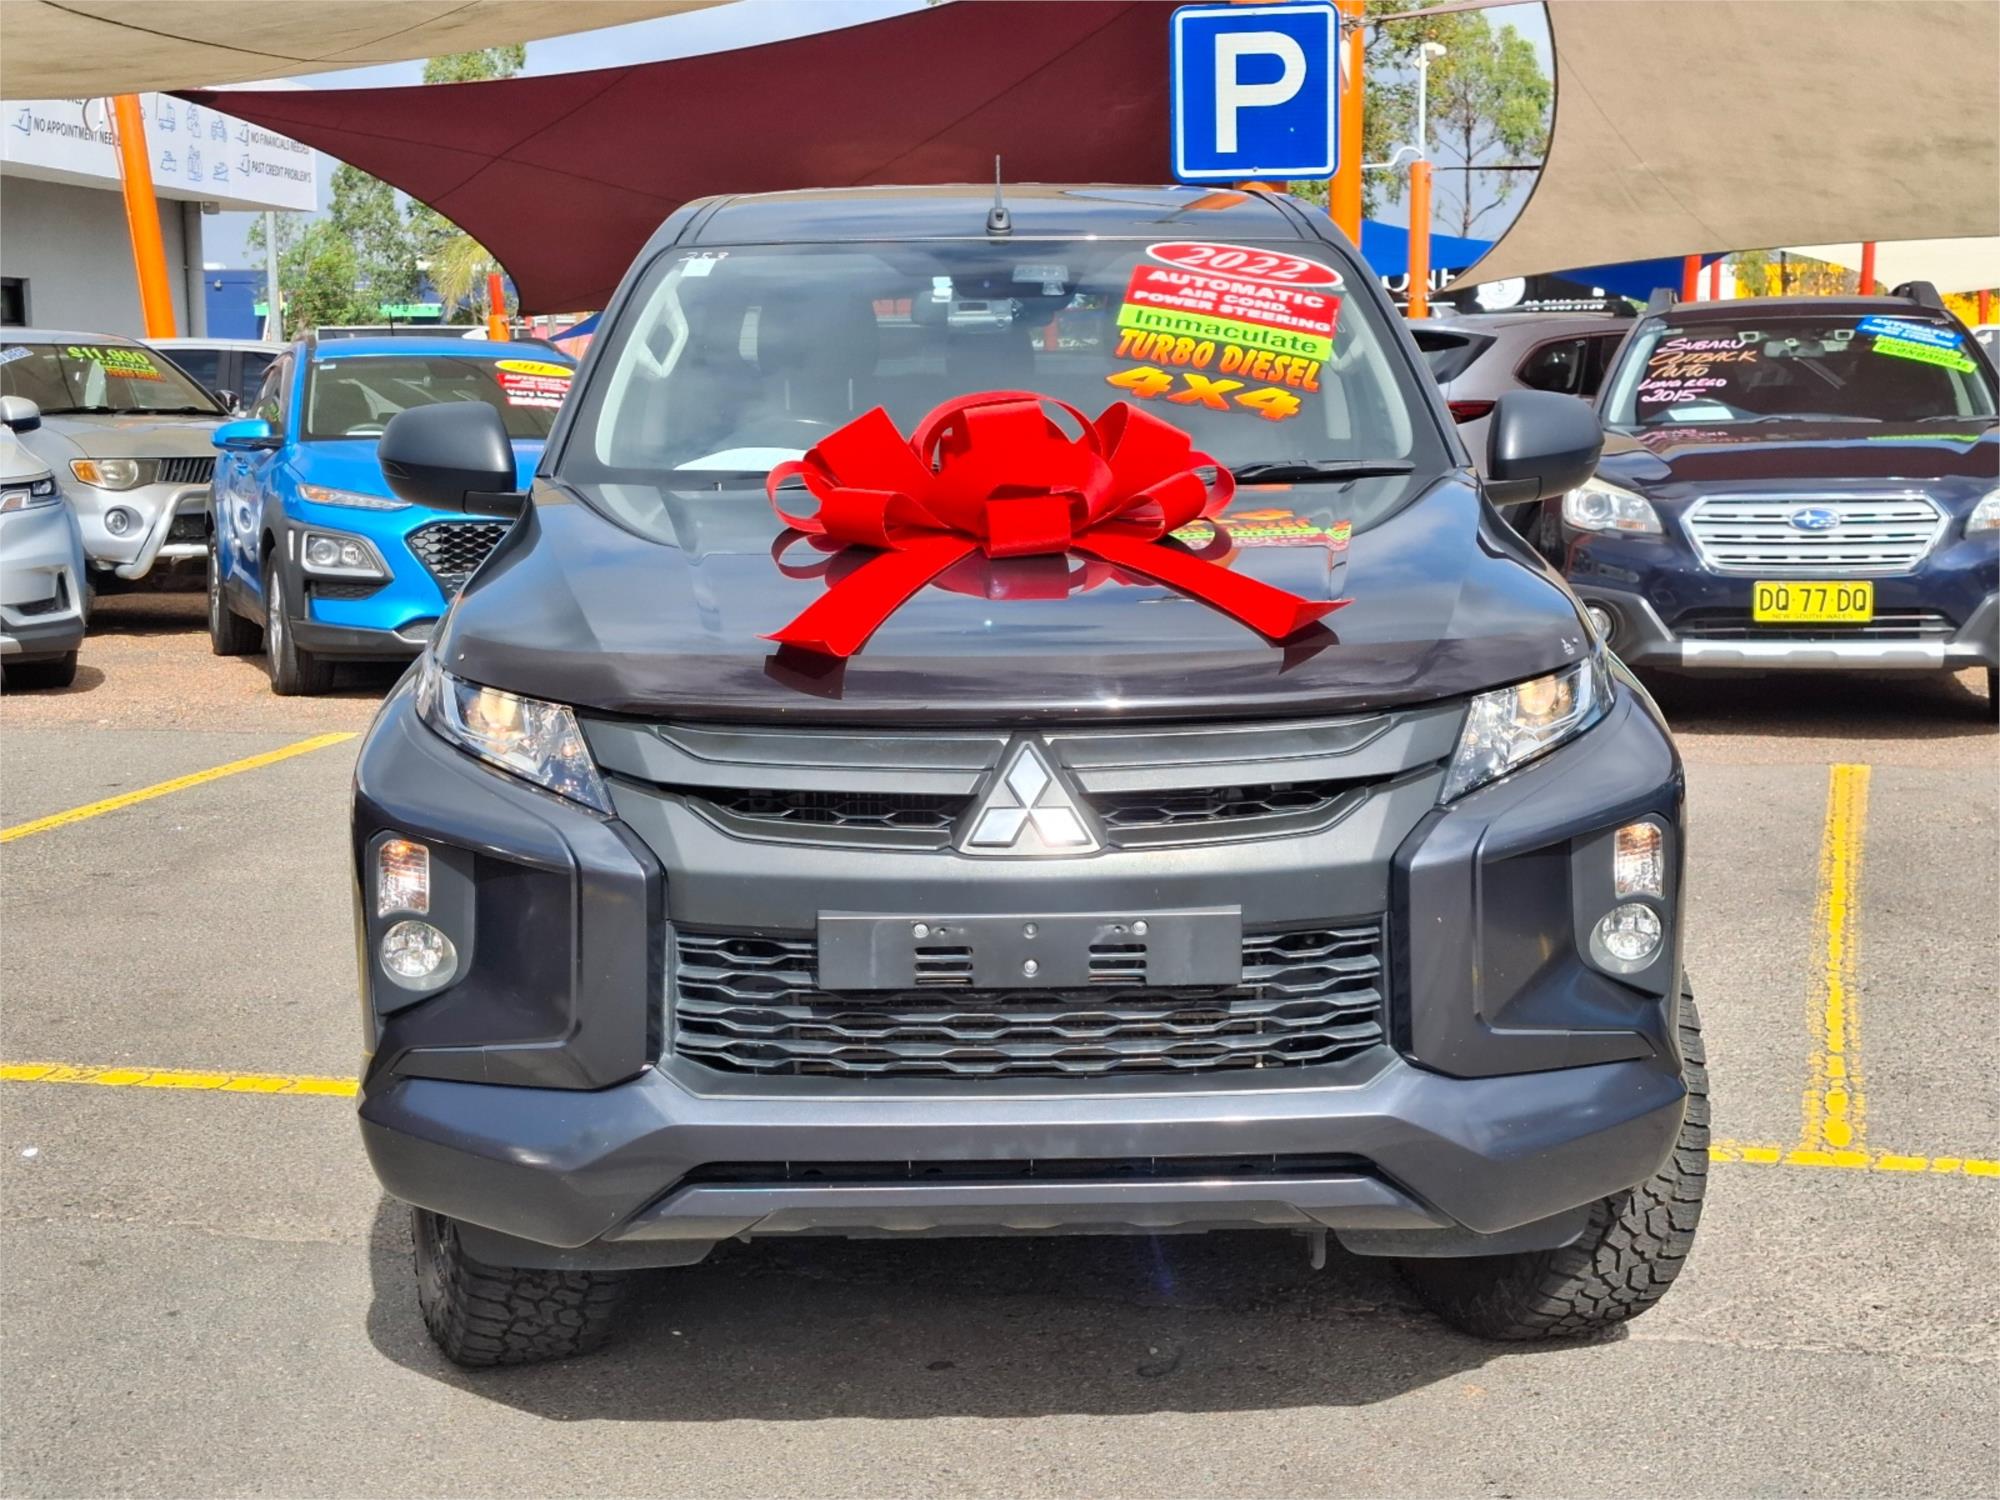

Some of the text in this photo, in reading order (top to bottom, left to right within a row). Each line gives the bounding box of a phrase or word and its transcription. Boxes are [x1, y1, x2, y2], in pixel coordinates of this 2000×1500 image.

[1215, 31, 1306, 153] P
[33, 117, 46, 132] NO
[47, 119, 98, 142] APPOINTMENT
[251, 160, 265, 174] PAST
[265, 163, 284, 178] CREDIT
[1180, 247, 1310, 279] 2022
[1147, 270, 1325, 308] AUTOMATIC
[1178, 287, 1292, 313] AIR COND.
[1133, 291, 1332, 332] POWER STEERING
[1135, 310, 1318, 354] Immaculate
[1648, 350, 1757, 366] OUTBACK
[1656, 338, 1746, 353] SUBARU
[1115, 329, 1321, 393] TURBO DIESEL
[1641, 388, 1707, 402] 2015
[1760, 588, 1866, 612] DQ 77 DQ
